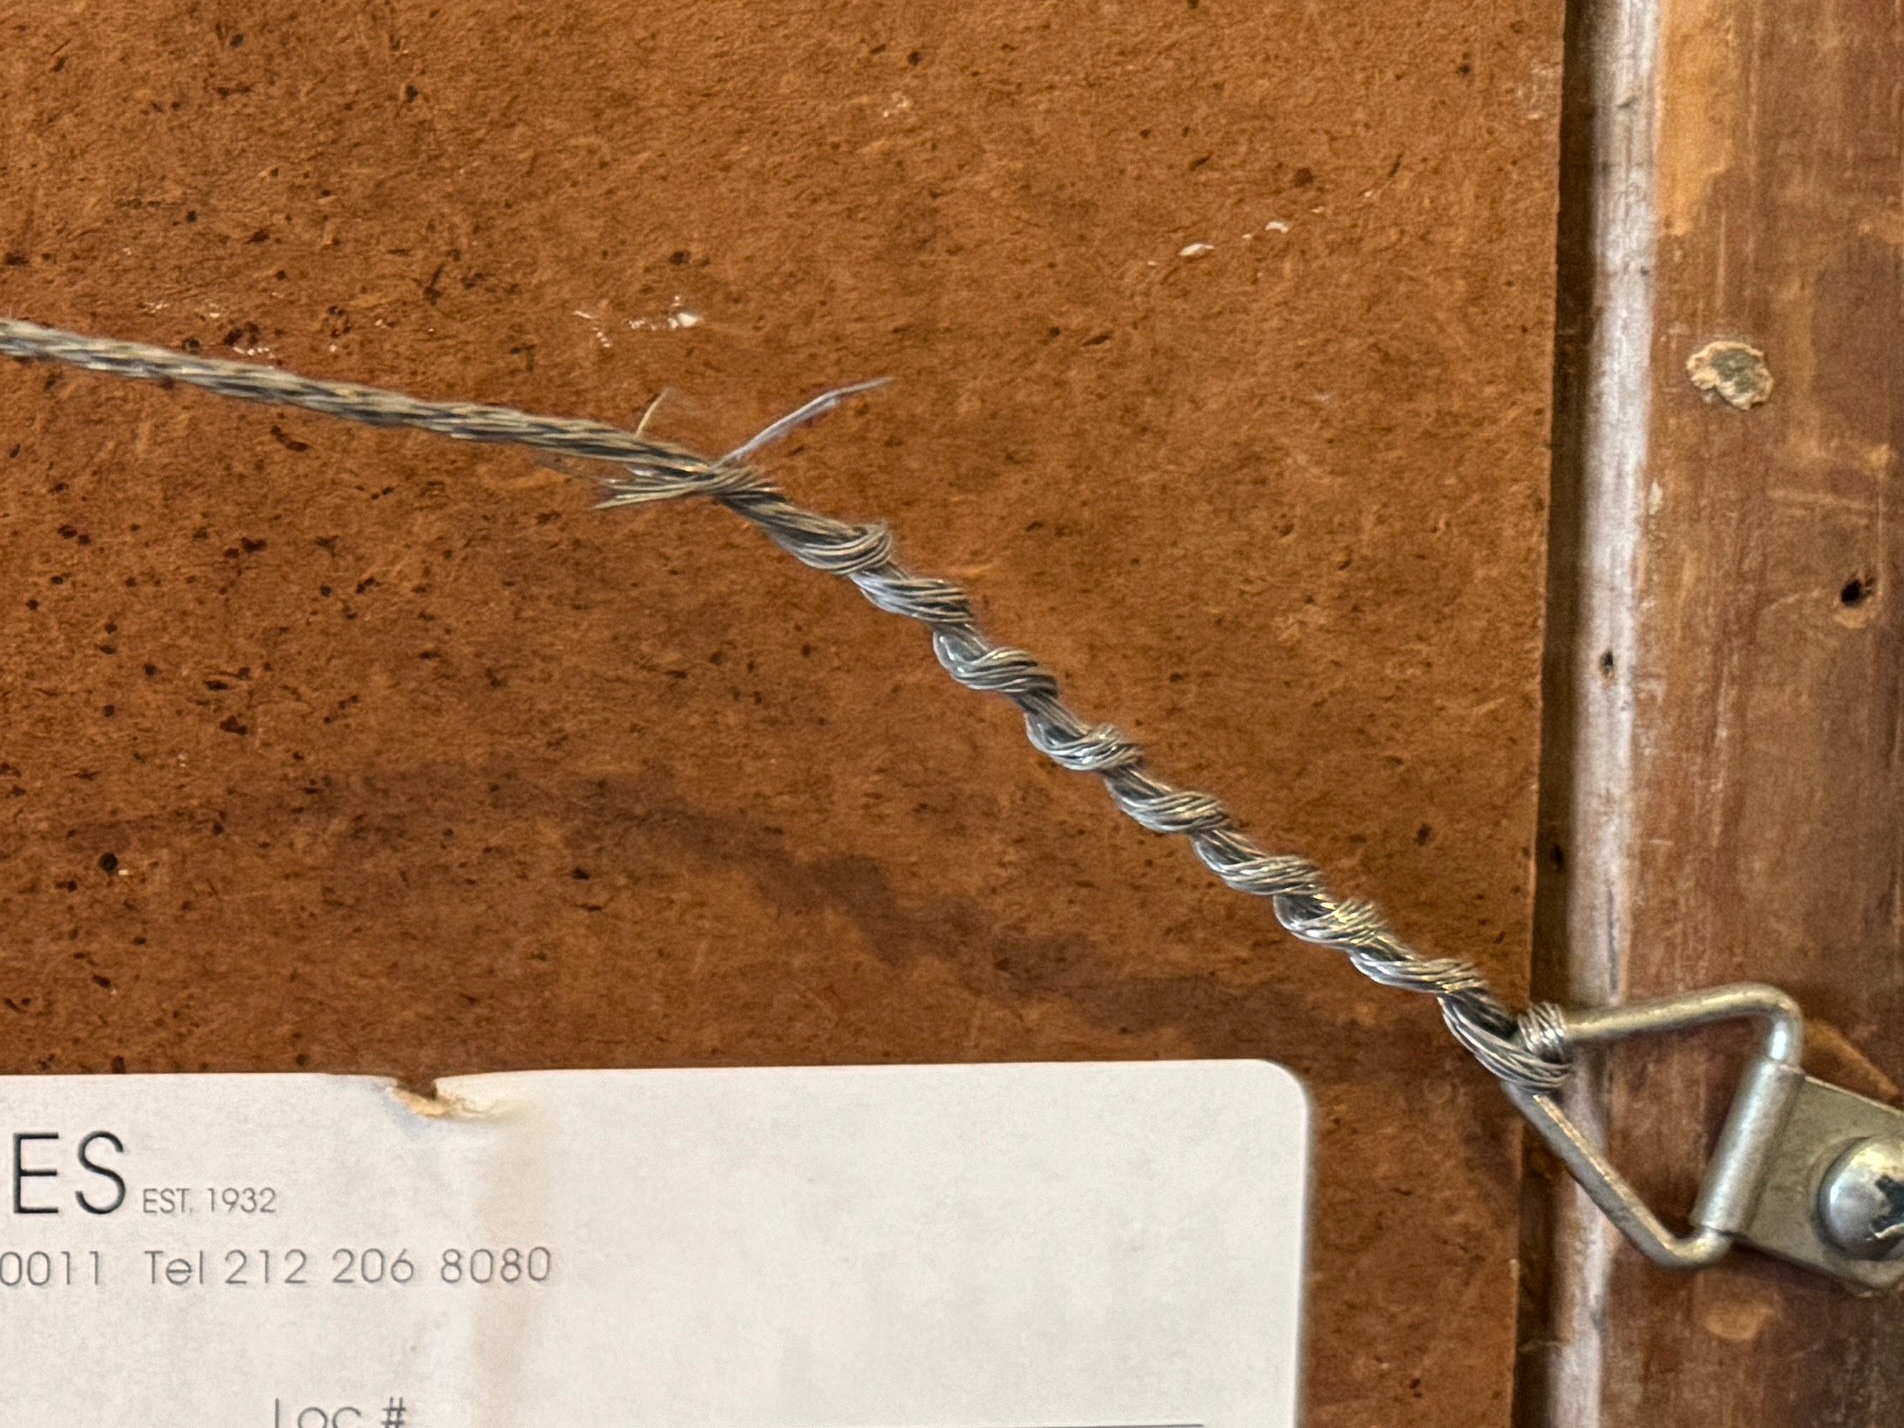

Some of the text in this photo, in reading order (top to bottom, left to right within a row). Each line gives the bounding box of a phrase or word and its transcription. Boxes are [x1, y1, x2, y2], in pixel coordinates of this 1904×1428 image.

[142, 1187, 194, 1215] EST.
[207, 1186, 278, 1215] 1932
[143, 1249, 205, 1287] Tel
[224, 1248, 309, 1286] 212
[332, 1247, 416, 1285] 206
[440, 1245, 552, 1285] 8080
